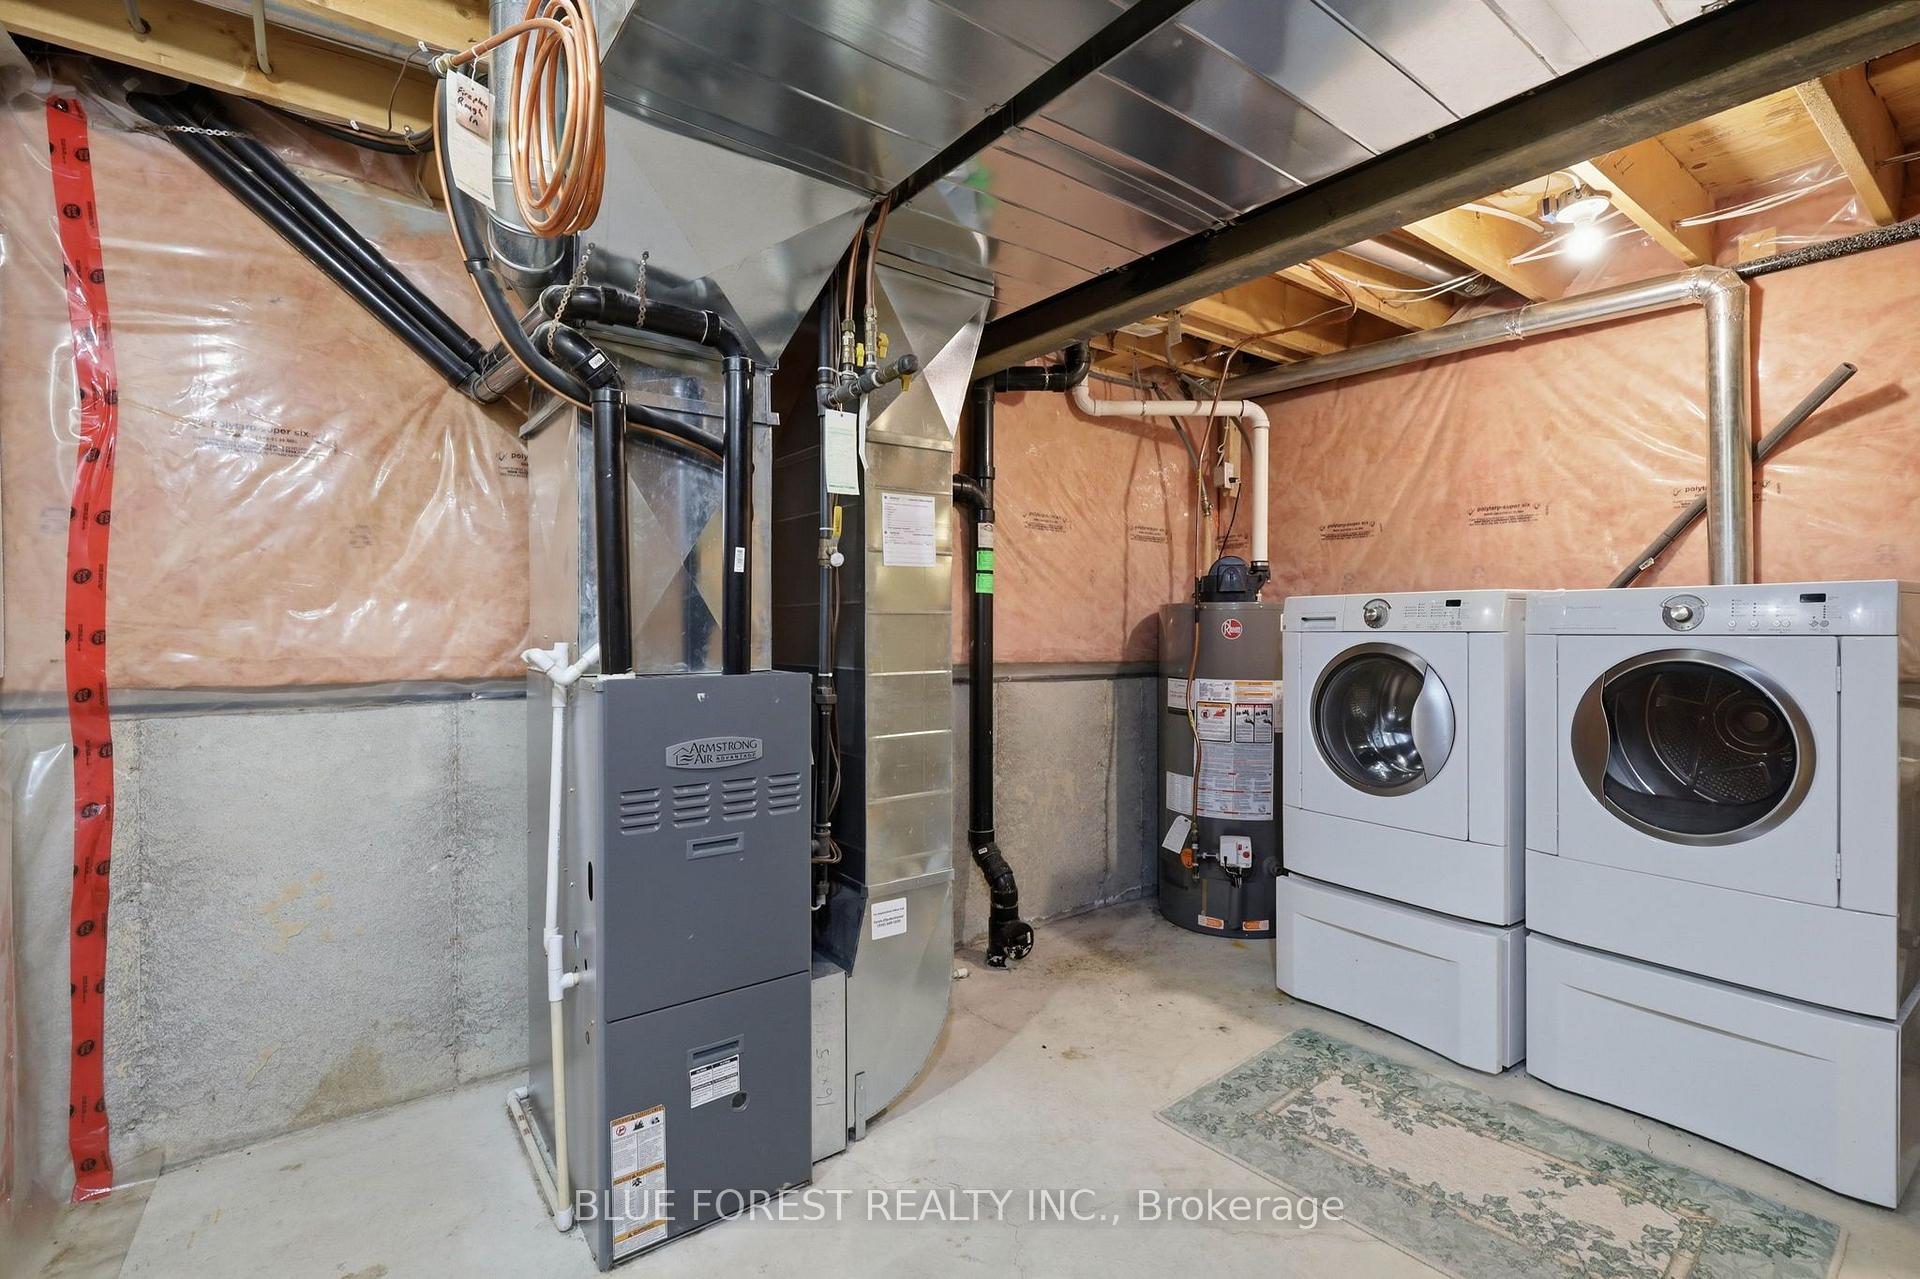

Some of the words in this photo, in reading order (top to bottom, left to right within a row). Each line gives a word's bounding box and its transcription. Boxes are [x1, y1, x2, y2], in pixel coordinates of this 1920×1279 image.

[457, 96, 484, 118] Rough
[690, 740, 757, 754] ARMSTRONG
[694, 753, 713, 765] AIR
